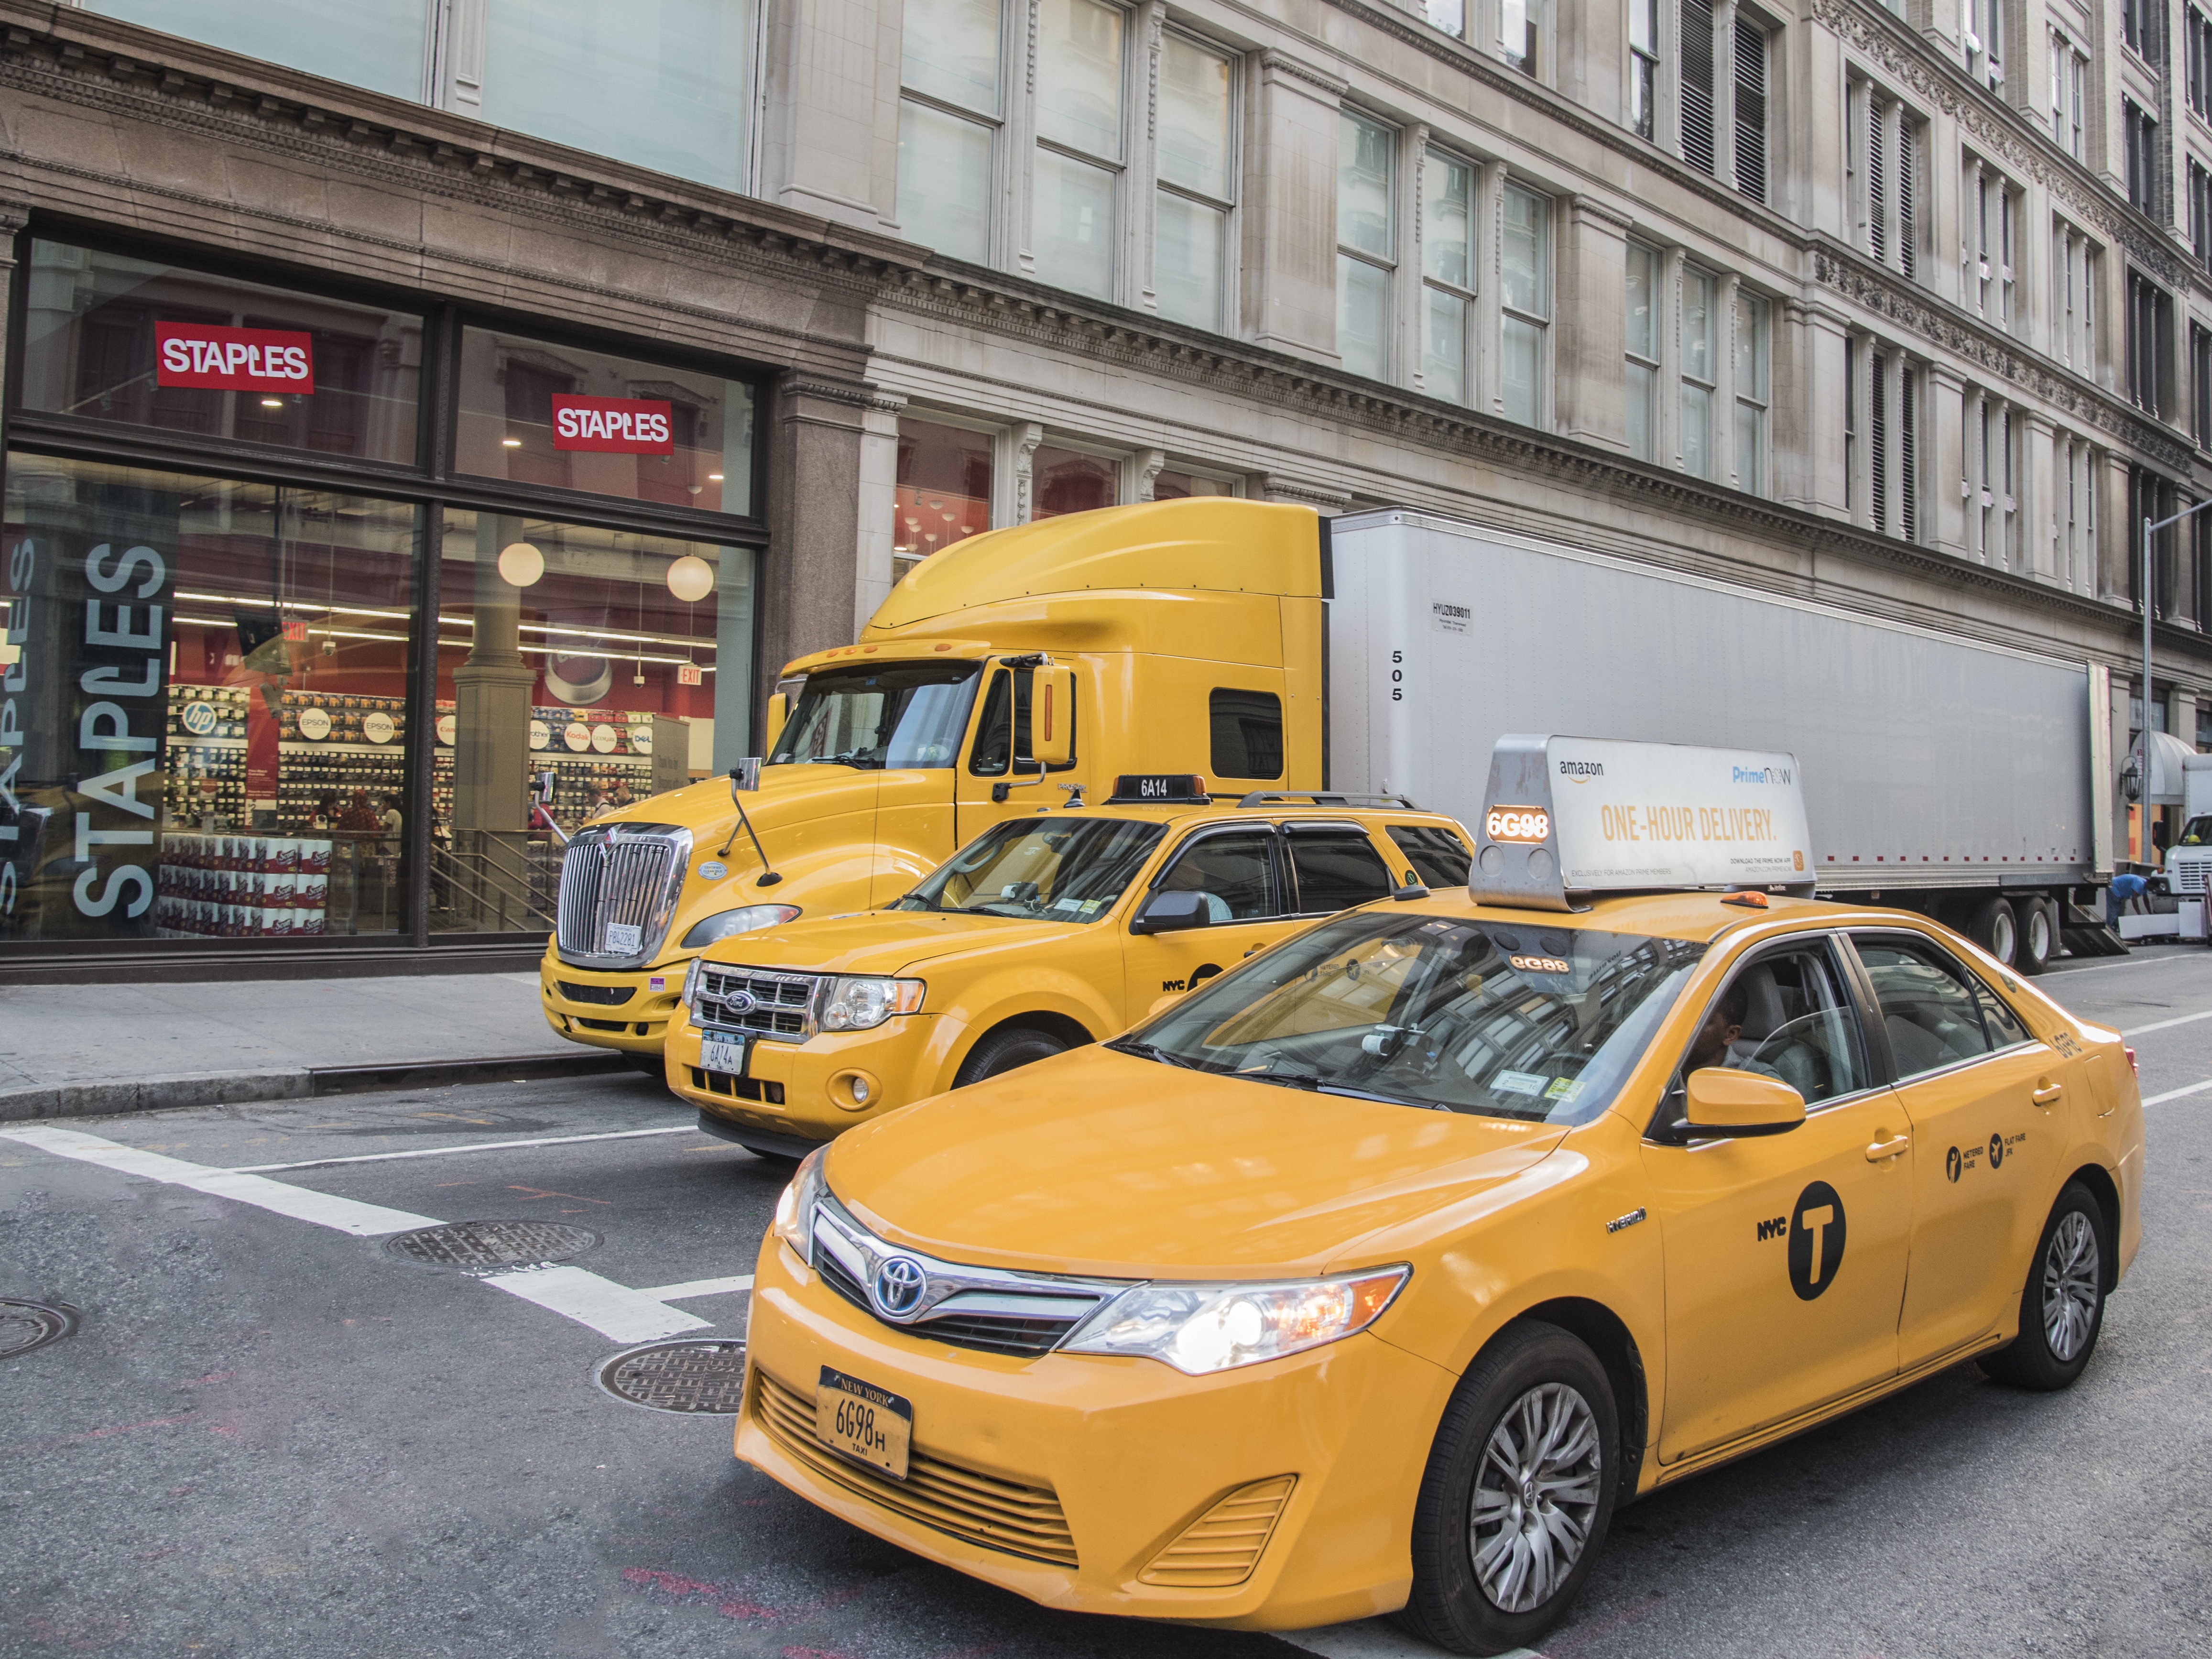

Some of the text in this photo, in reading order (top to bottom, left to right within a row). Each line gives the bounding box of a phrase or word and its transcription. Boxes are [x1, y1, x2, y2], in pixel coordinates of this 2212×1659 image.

[163, 338, 309, 380] STAPLES
[558, 408, 669, 442] STAPLES
[1433, 602, 1471, 619] HYUZ039011
[683, 669, 699, 683] EXIT
[188, 703, 212, 731] hp
[73, 543, 165, 919] STAPLES
[567, 731, 589, 741] Kodak
[1560, 761, 1604, 775] amazon
[1141, 779, 1167, 797] 6A14
[1488, 812, 1548, 838] 6G98
[1602, 804, 1777, 841] ONE-HOUR DELIVERY.
[1163, 980, 1185, 992] NYC
[728, 995, 744, 1007] Ford
[2005, 1133, 2026, 1146] FLAT FARE
[1963, 1146, 1983, 1159] METERED
[2005, 1147, 2013, 1157] JFK
[1964, 1159, 1975, 1170] FARE
[1757, 1204, 1834, 1285] NYC T
[840, 1378, 889, 1408] NEW YORK
[852, 1443, 868, 1456] TAXI
